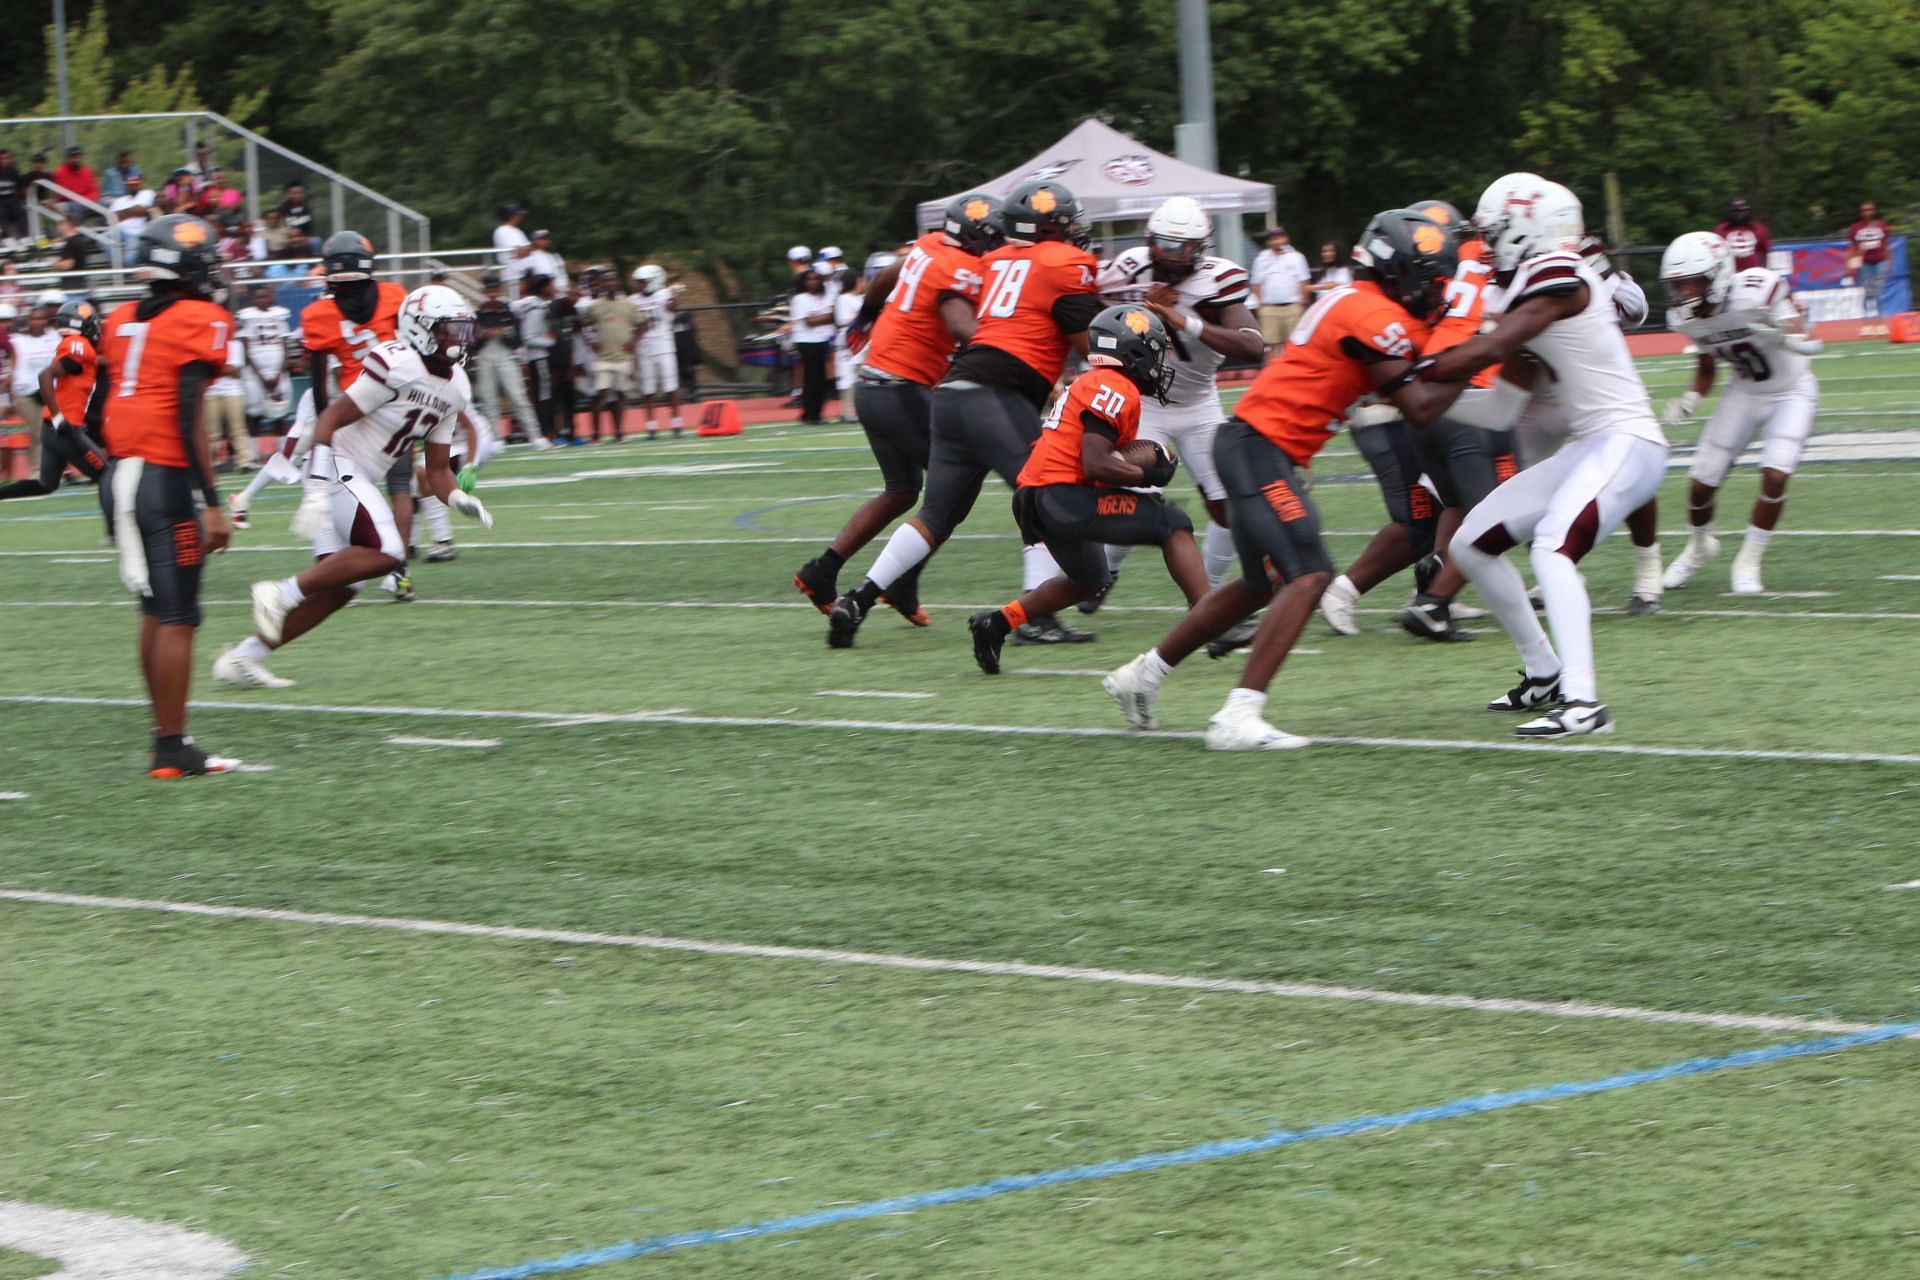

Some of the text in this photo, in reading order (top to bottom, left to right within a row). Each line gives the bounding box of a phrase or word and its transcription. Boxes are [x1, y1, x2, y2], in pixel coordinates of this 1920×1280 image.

[977, 259, 1031, 318] 78
[115, 322, 152, 397] 7
[1091, 384, 1126, 419] 20
[382, 408, 441, 458] 12
